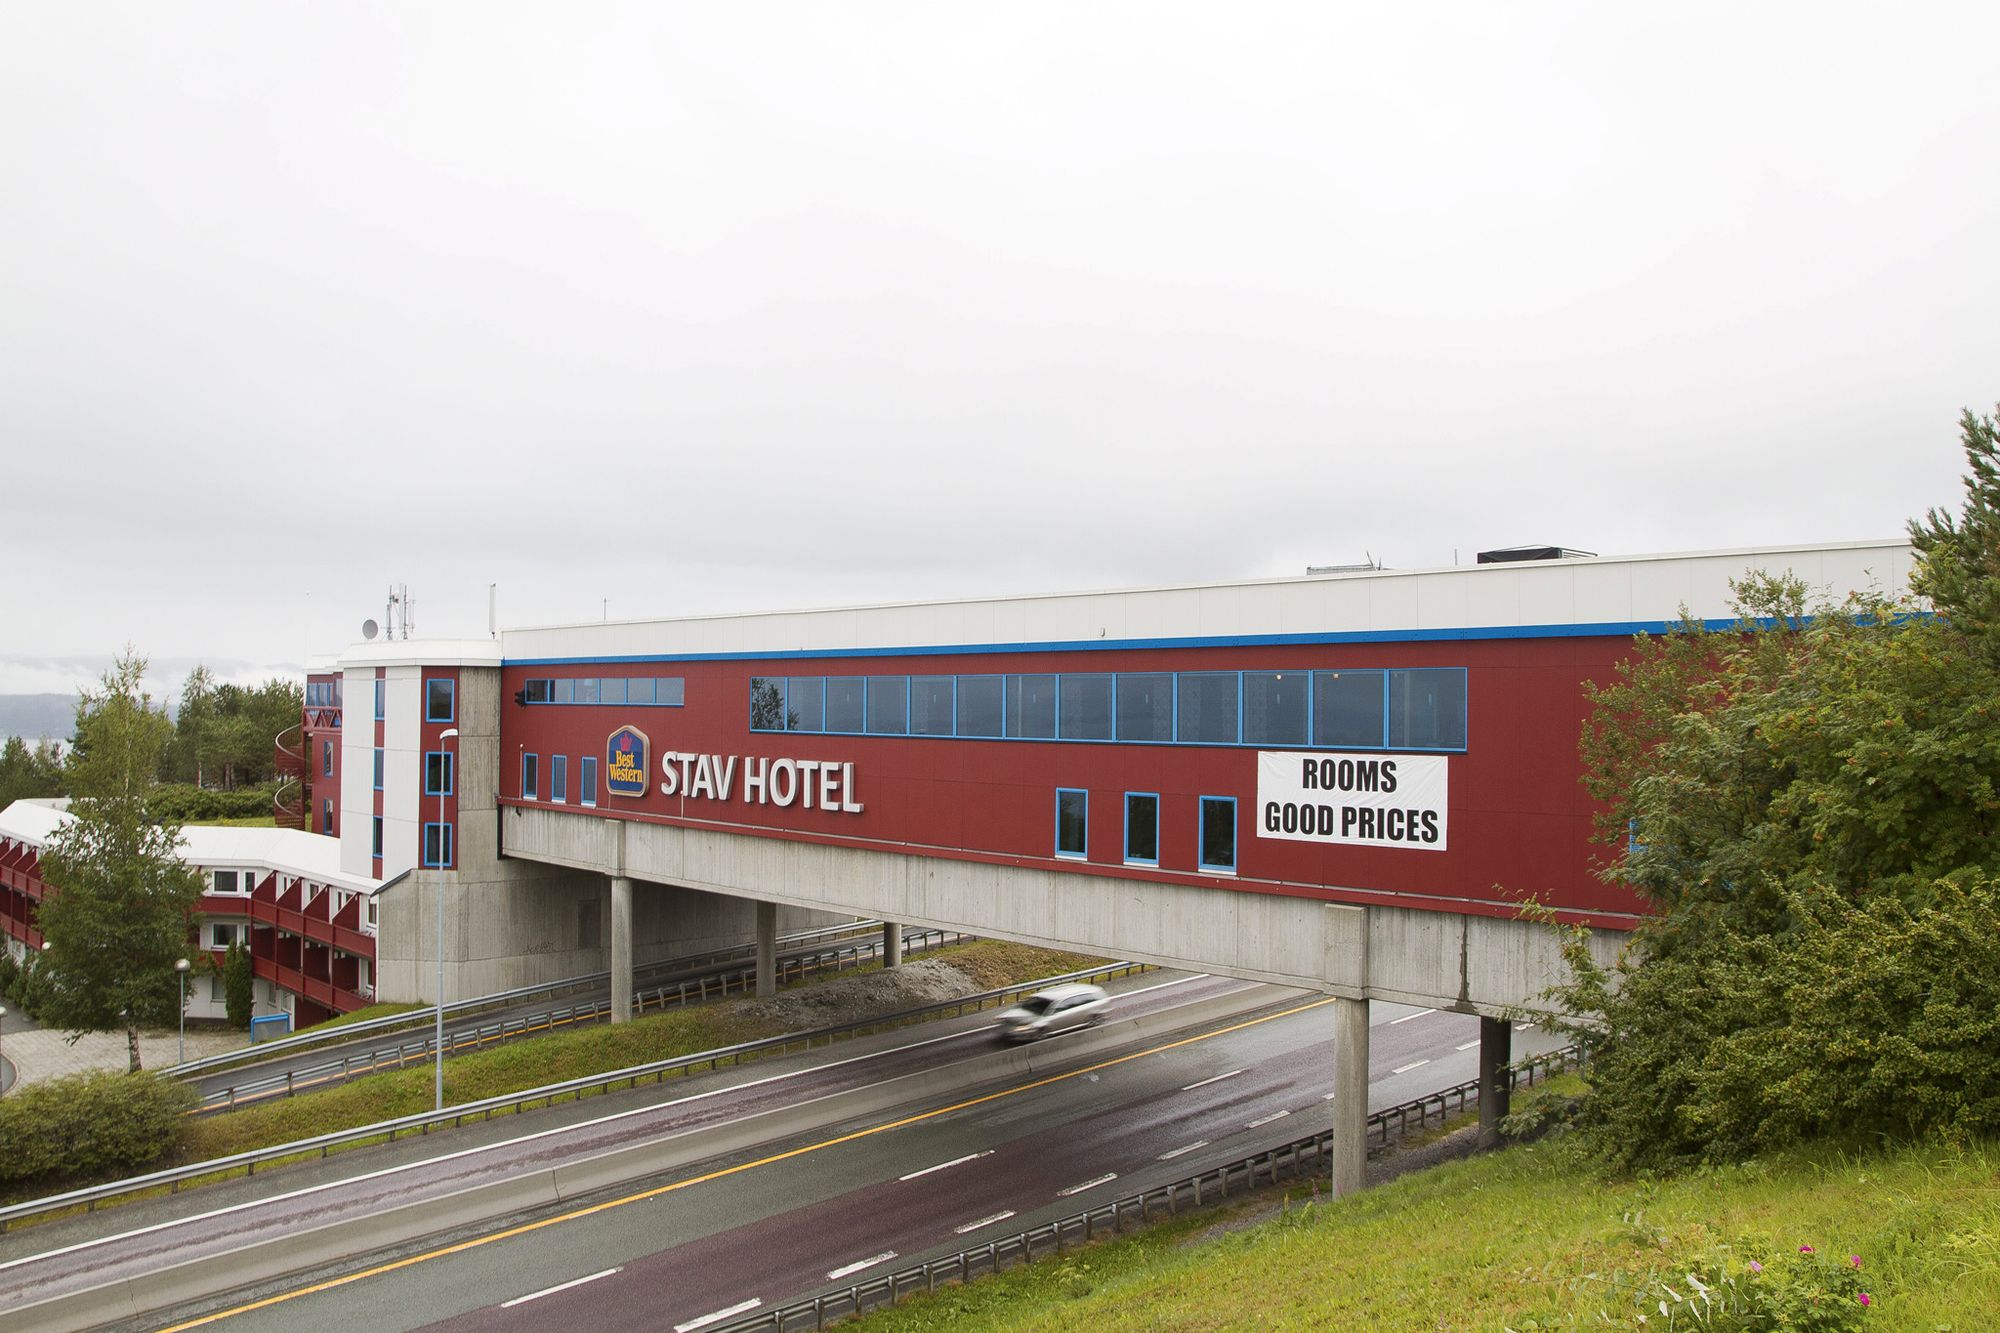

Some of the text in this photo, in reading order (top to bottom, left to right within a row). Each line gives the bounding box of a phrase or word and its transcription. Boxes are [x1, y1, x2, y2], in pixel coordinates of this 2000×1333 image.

[609, 764, 643, 783] Western
[615, 750, 635, 767] Best
[1302, 758, 1397, 793] ROOMS
[661, 751, 864, 813] STAV HOTEL
[1265, 801, 1439, 843] GOOD PRICES
